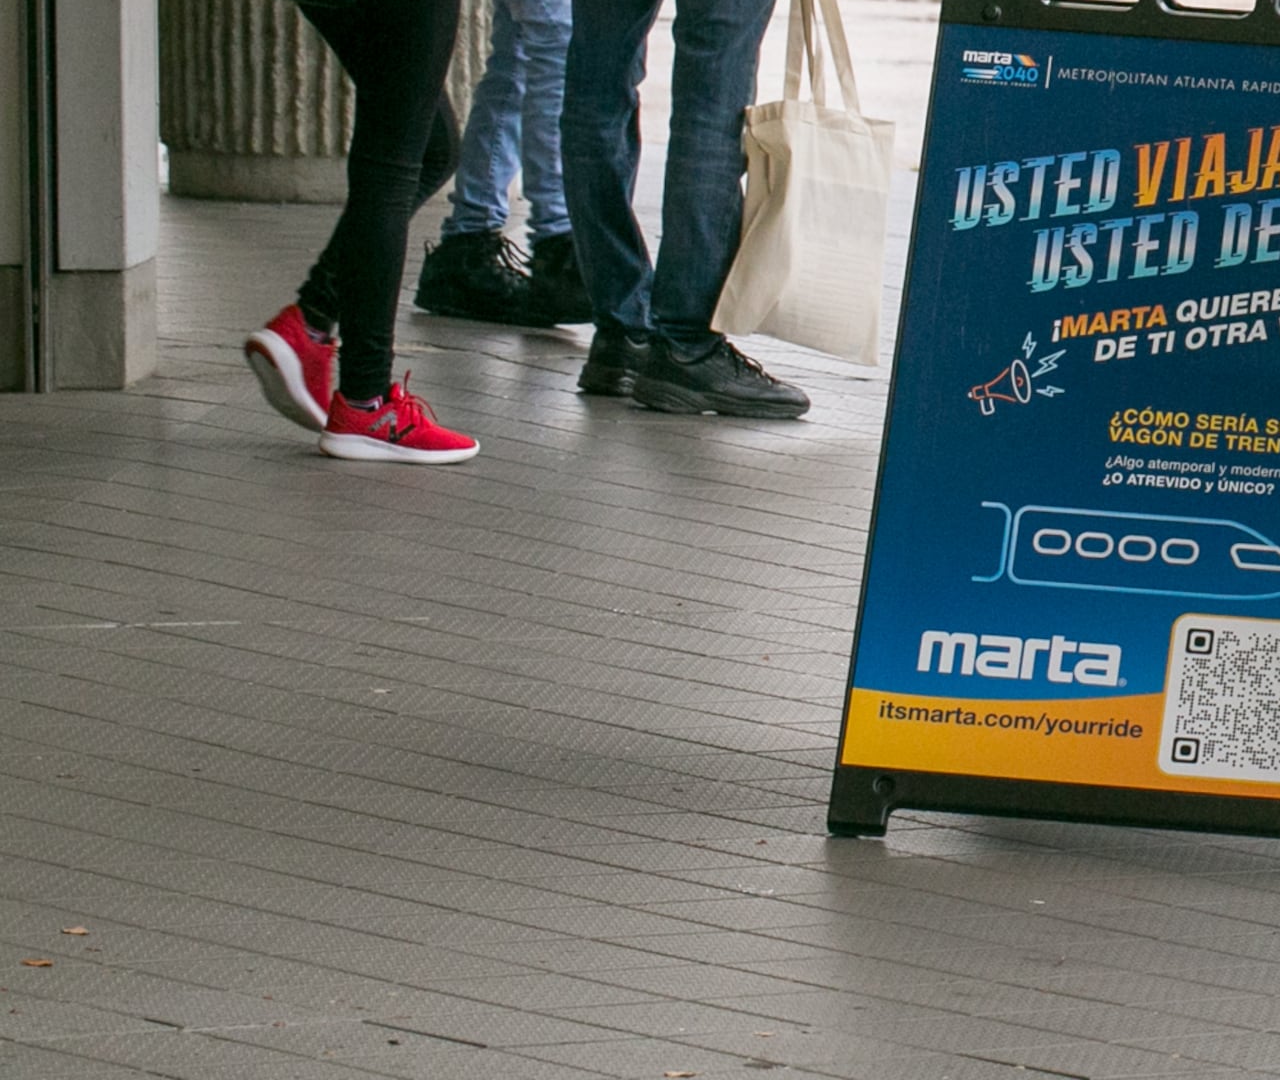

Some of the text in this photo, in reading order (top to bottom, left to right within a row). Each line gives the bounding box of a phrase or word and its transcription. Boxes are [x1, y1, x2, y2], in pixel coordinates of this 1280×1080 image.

[962, 50, 1012, 65] marta
[994, 66, 1039, 82] 2040
[1057, 68, 1168, 86] METROPOLITAN
[1174, 76, 1235, 90] ATLANTA
[949, 148, 1121, 231] USTED
[1026, 210, 1200, 293] USTED
[1052, 304, 1168, 343] ¡MARTA
[1094, 336, 1137, 362] DE
[1149, 330, 1175, 355] TI
[1185, 320, 1268, 351] OTRA
[1110, 406, 1189, 429] ¿CÓMO
[1196, 412, 1260, 433] SERÍA
[1108, 423, 1184, 447] VAGÓN
[1189, 431, 1219, 449] DE
[1225, 434, 1280, 454] TREN
[1105, 455, 1144, 470] ¿Algo
[1147, 458, 1215, 474] atemporal
[1218, 465, 1228, 477] y
[1102, 472, 1275, 495] ¿O ATREVIDO y ÚNICO?
[878, 699, 1143, 739] itsmarta.com/yourride
